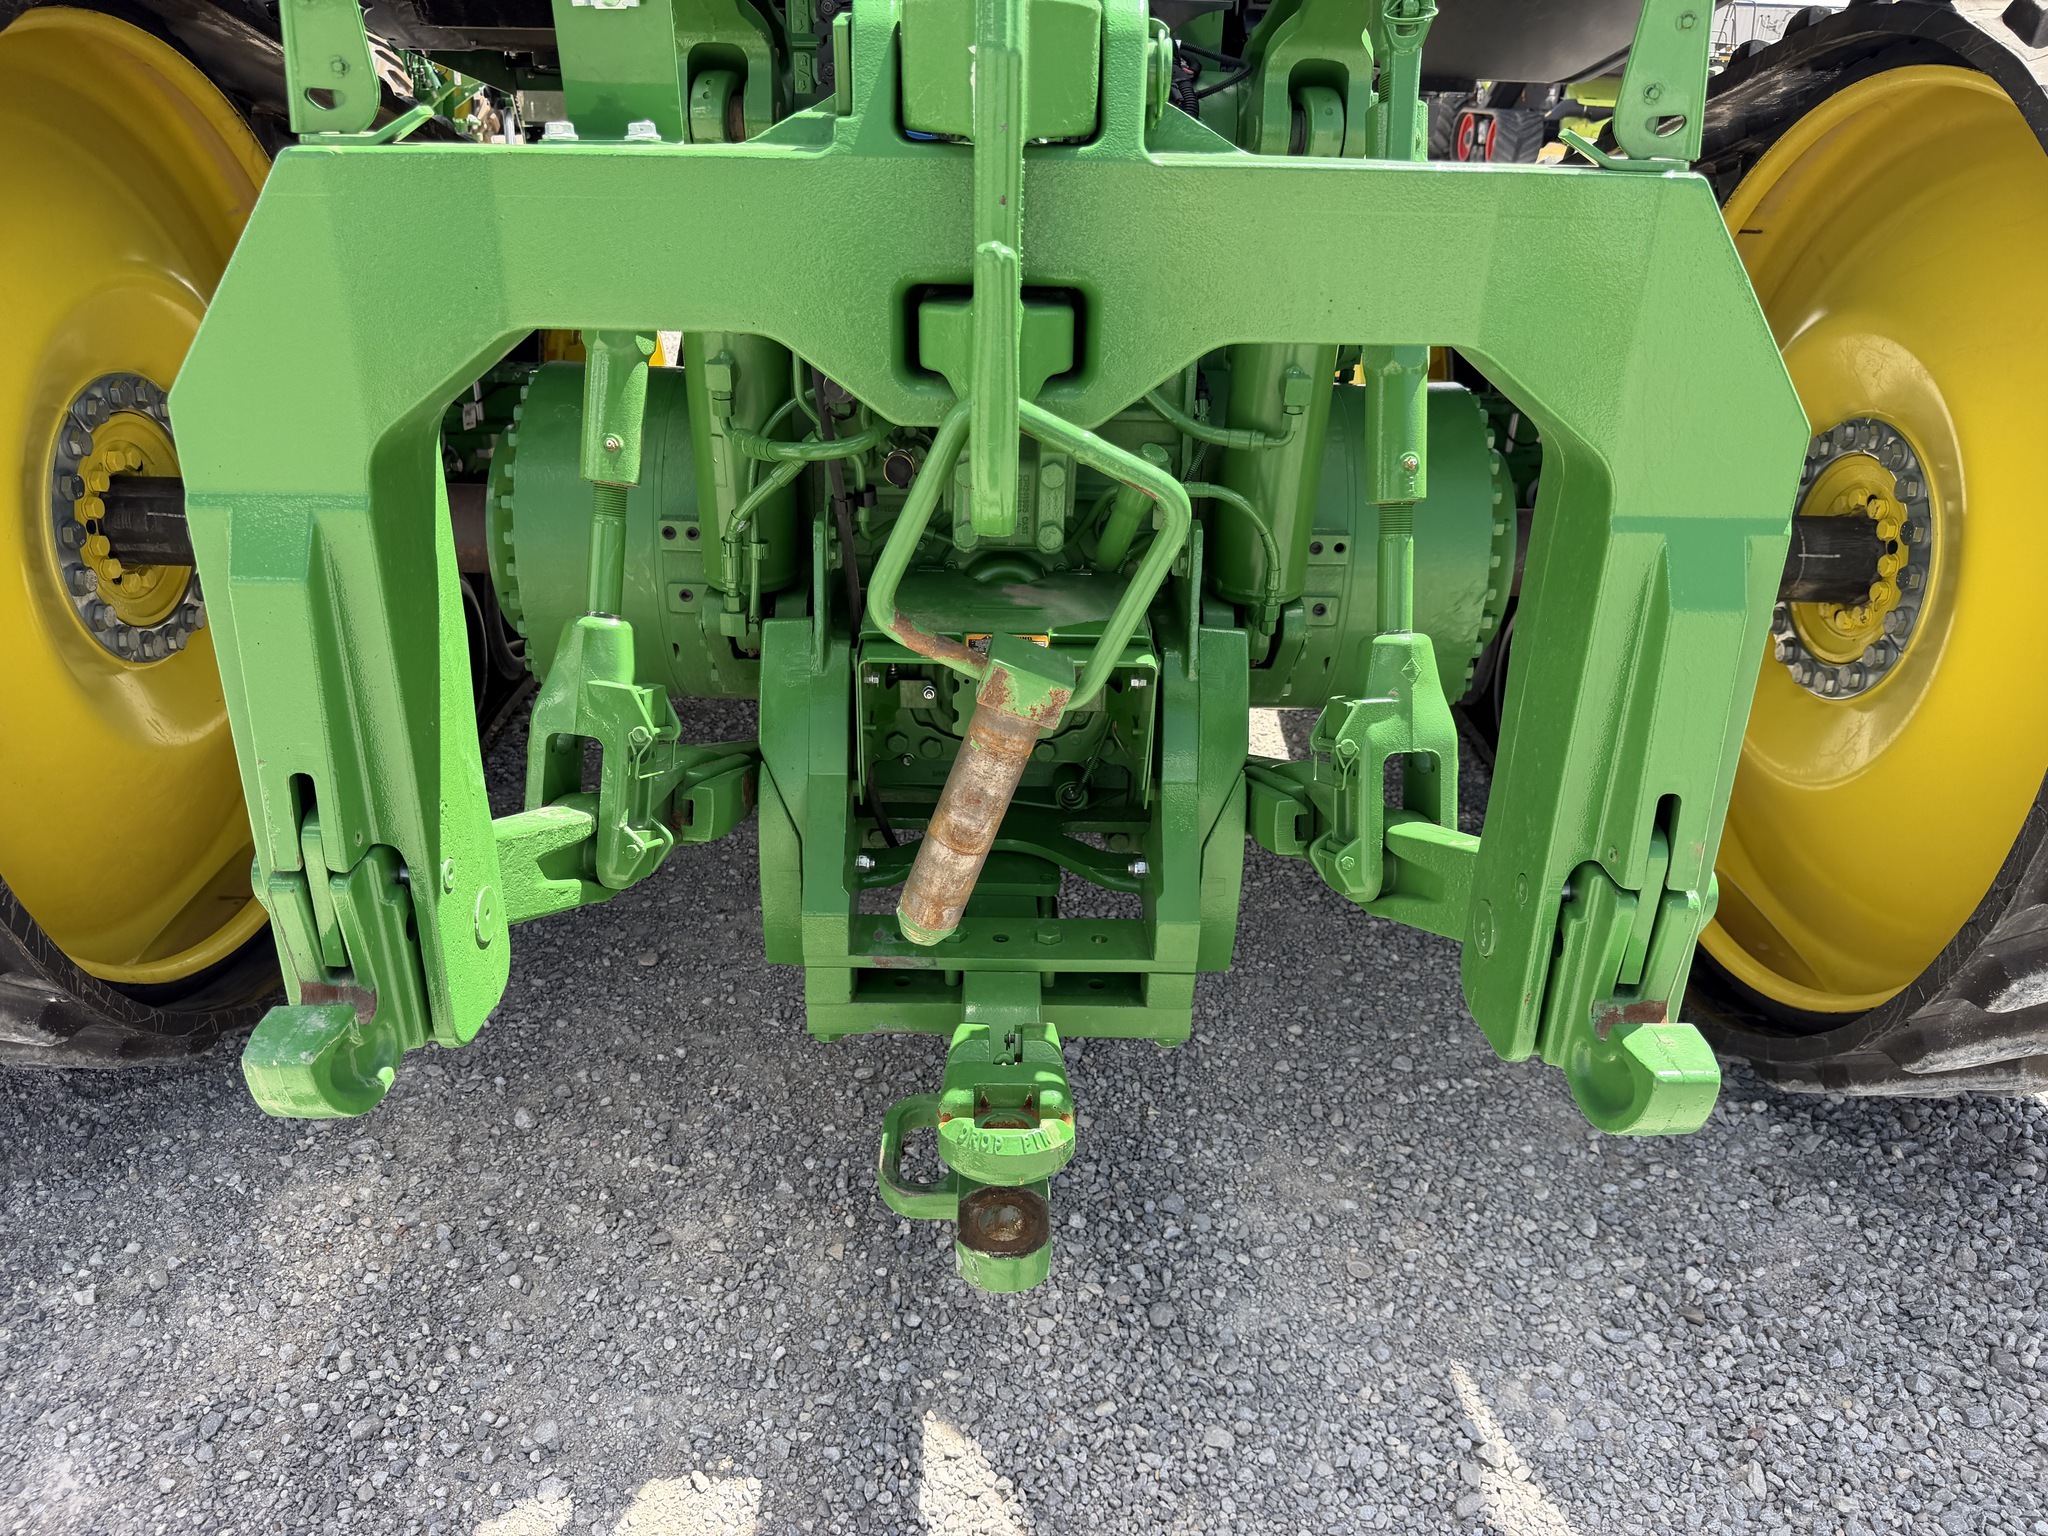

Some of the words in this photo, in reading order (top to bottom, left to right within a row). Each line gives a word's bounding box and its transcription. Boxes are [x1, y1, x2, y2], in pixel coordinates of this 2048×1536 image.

[1021, 516, 1029, 535] CAST
[956, 1125, 1003, 1155] DROP
[1019, 1129, 1053, 1154] PIN
